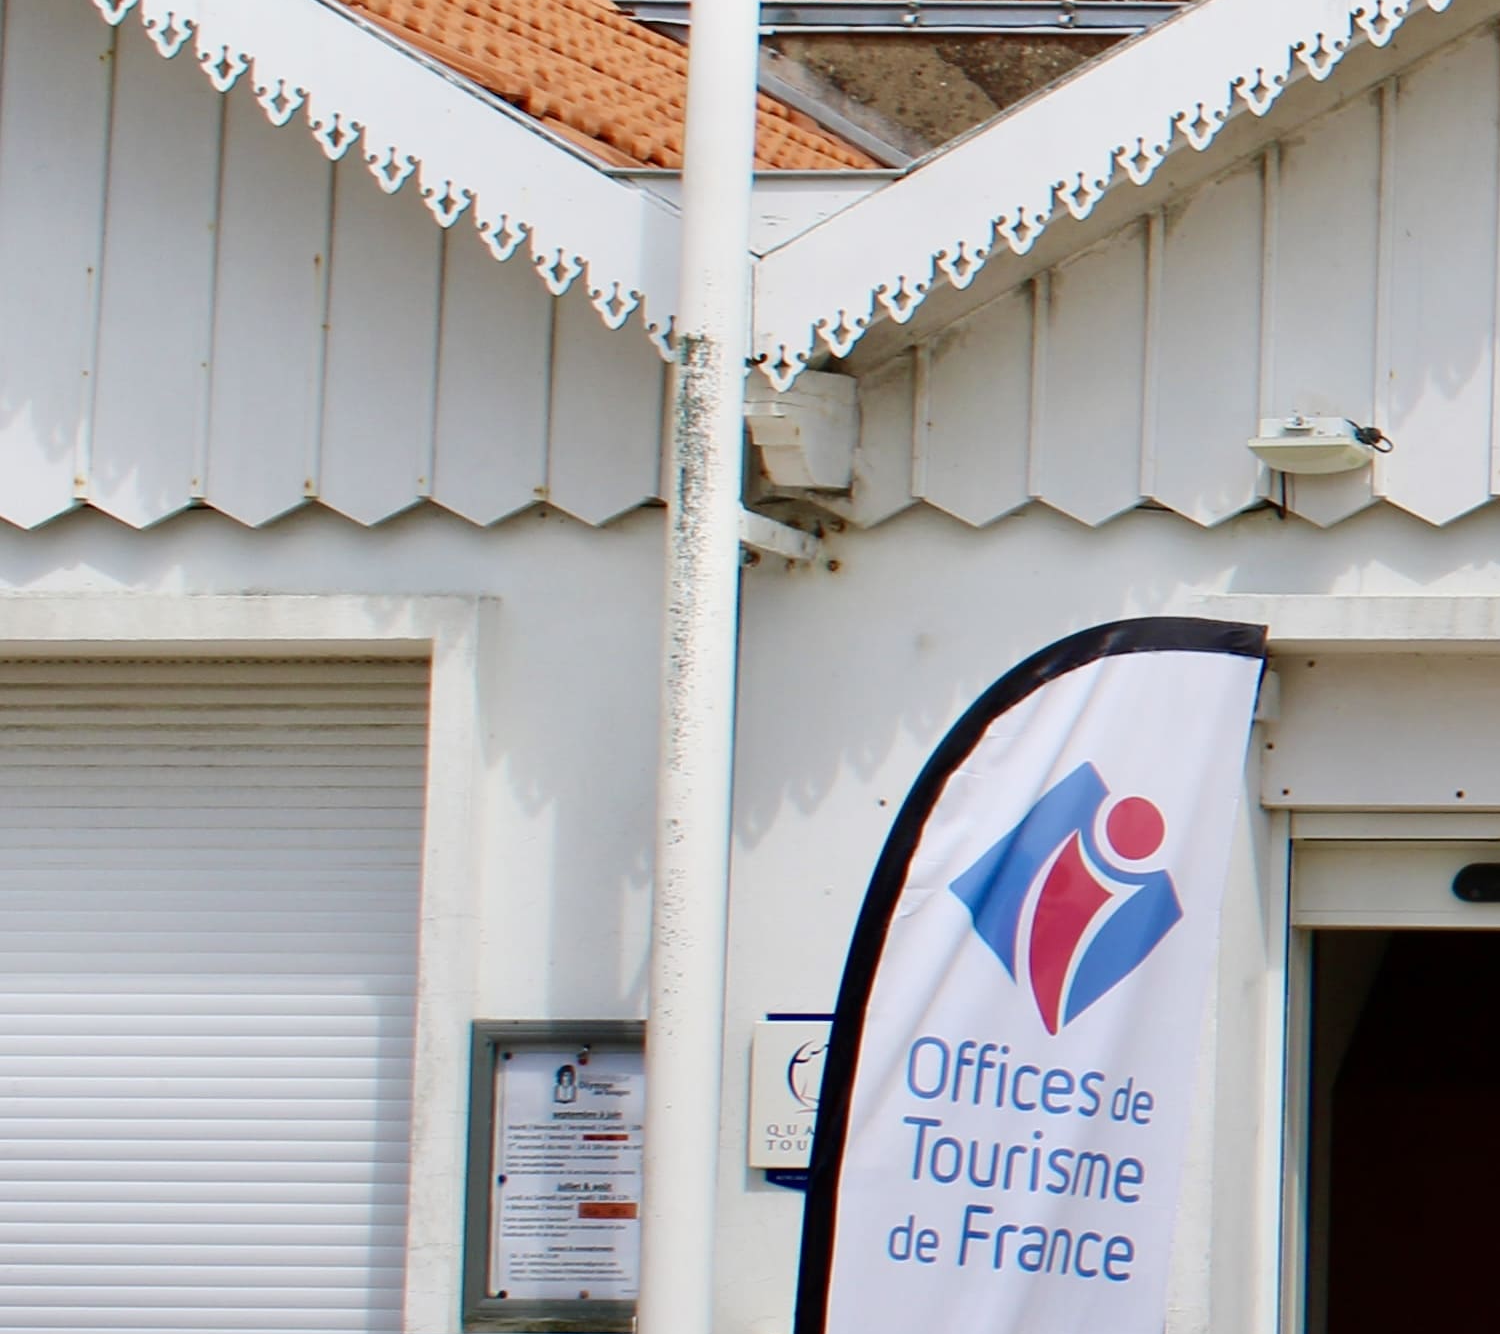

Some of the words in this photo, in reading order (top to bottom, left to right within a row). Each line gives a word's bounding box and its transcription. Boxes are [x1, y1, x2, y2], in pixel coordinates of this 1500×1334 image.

[907, 1034, 1106, 1118] Offices
[1111, 1078, 1155, 1126] de
[765, 1122, 816, 1139] QUA
[765, 1138, 809, 1151] TOU
[903, 1116, 1146, 1204] Tourisme
[887, 1214, 938, 1266] de
[957, 1203, 1135, 1283] France
